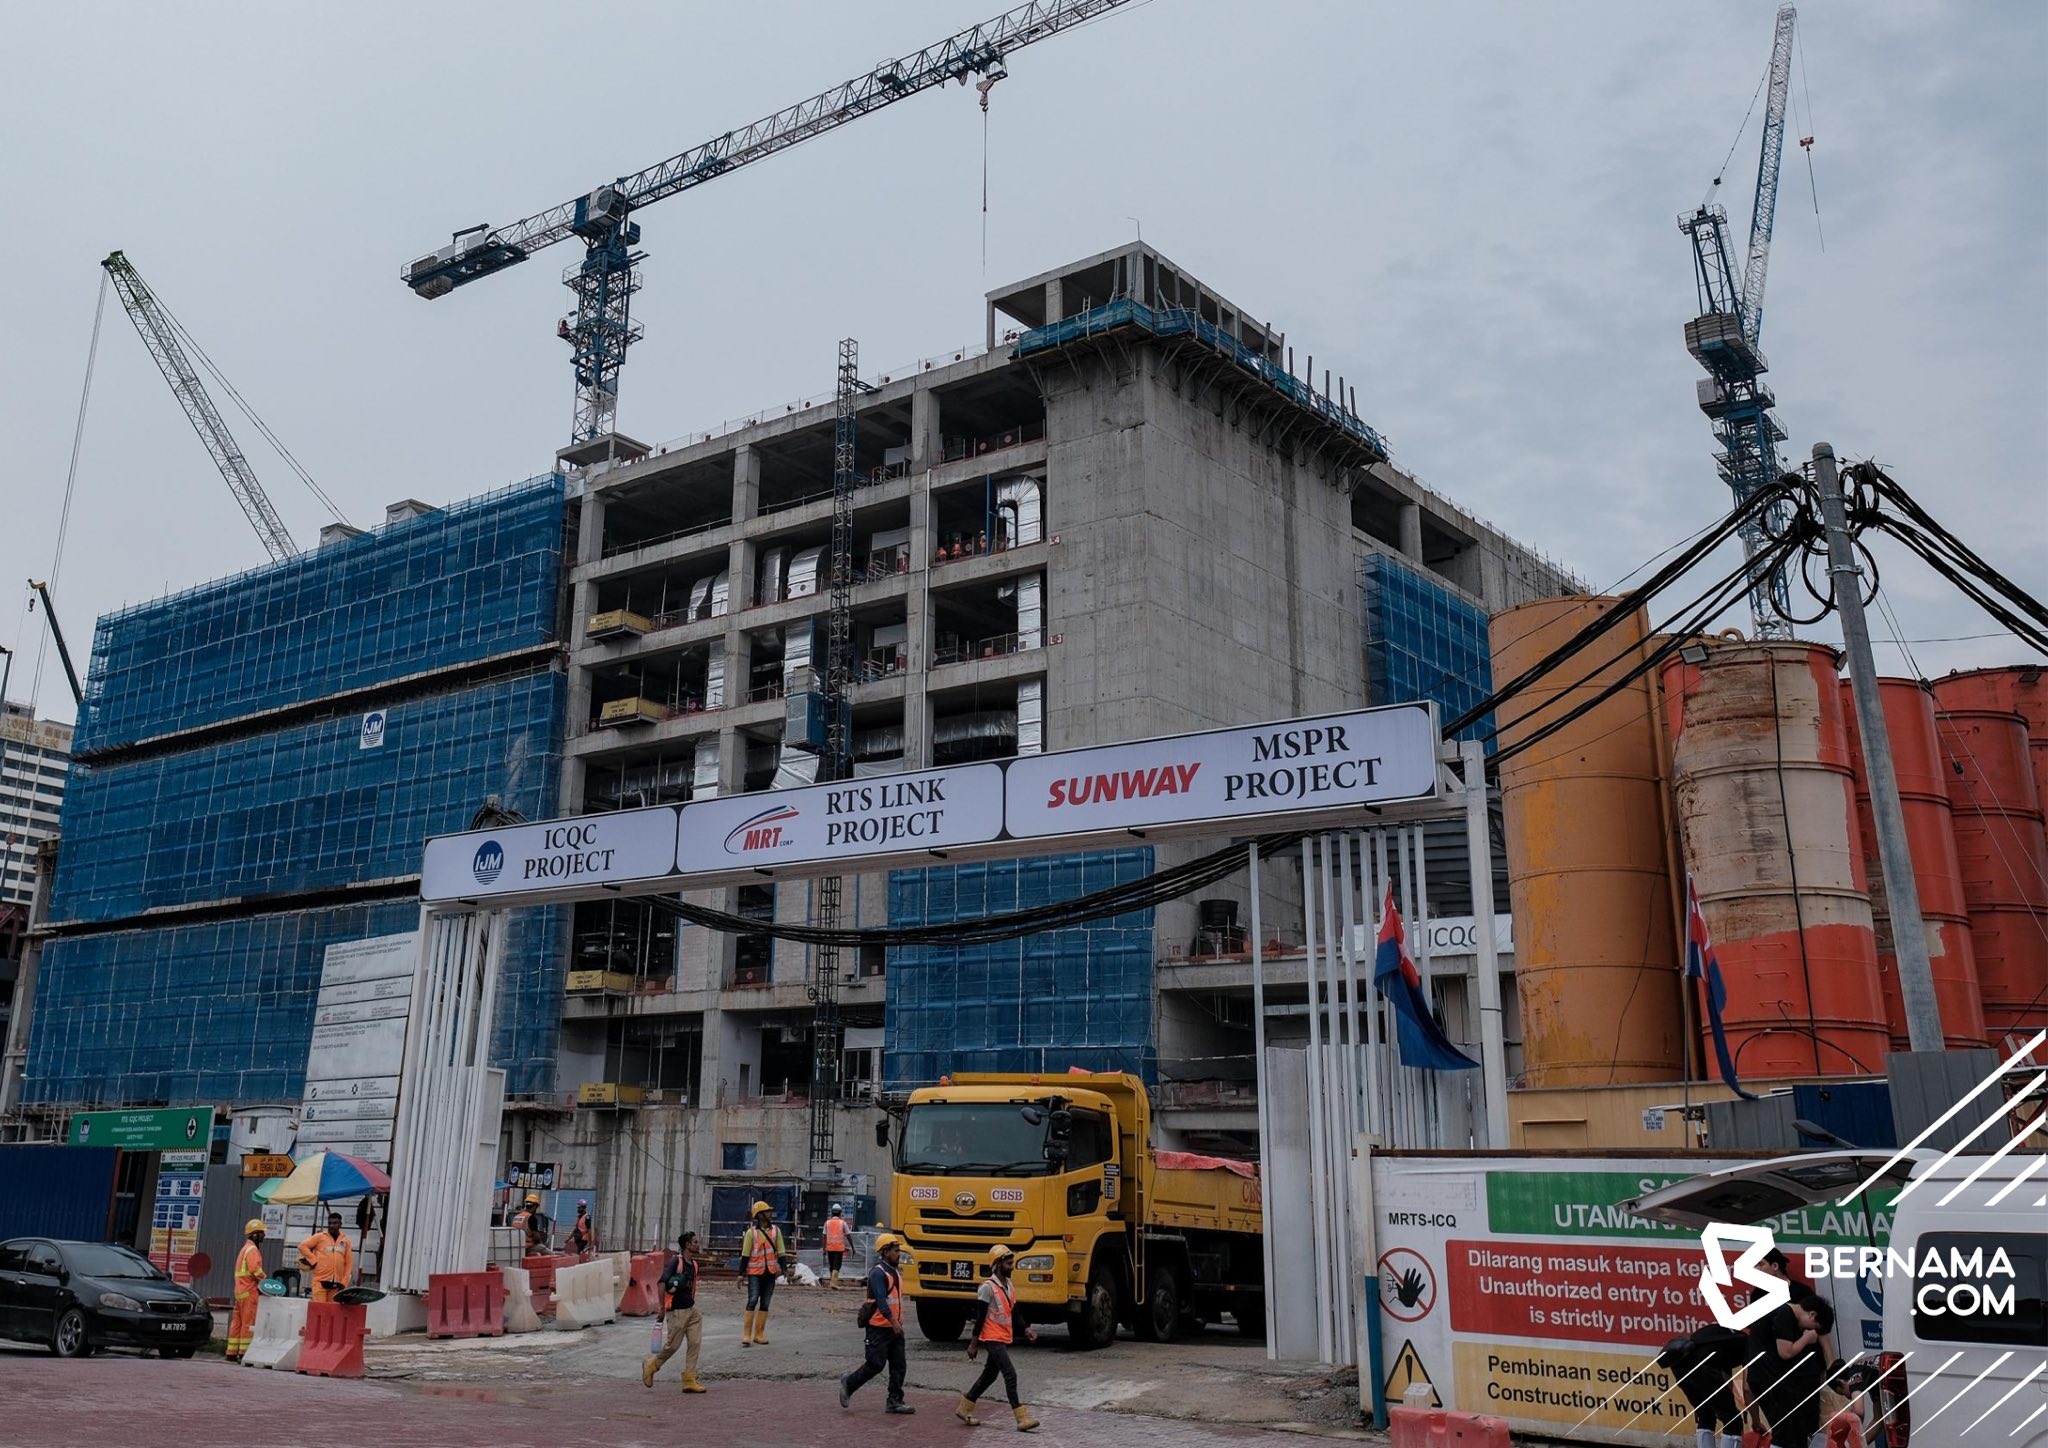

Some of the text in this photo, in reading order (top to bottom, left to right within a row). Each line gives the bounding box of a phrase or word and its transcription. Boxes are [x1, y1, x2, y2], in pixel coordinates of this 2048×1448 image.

[364, 719, 383, 735] IJM
[1252, 725, 1350, 762] MSPR
[1047, 762, 1201, 809] SUNWAY
[1224, 757, 1382, 801] PROJECT
[826, 777, 946, 815] RTS LINK
[544, 824, 597, 849] ICQC
[743, 827, 783, 850] MRT
[826, 810, 944, 846] PROJECT
[779, 839, 794, 847] CORP
[475, 852, 502, 872] IJM
[523, 849, 615, 879] PROJECT
[911, 1188, 939, 1198] CBSB
[992, 1190, 1023, 1200] CBSB
[953, 1269, 970, 1278] 2352
[1468, 1249, 1543, 1274] Dilarang
[1548, 1255, 1611, 1273] masuk
[1615, 1257, 1671, 1278] tanpa
[1479, 1275, 1601, 1300] Unauthorized
[1608, 1287, 1658, 1308] entry
[1662, 1287, 1685, 1304] to
[1529, 1306, 1545, 1323] is
[1551, 1308, 1614, 1332] strictly
[1488, 1355, 1669, 1391] Pembinaan sedang
[1487, 1382, 1687, 1417] Construction work in
